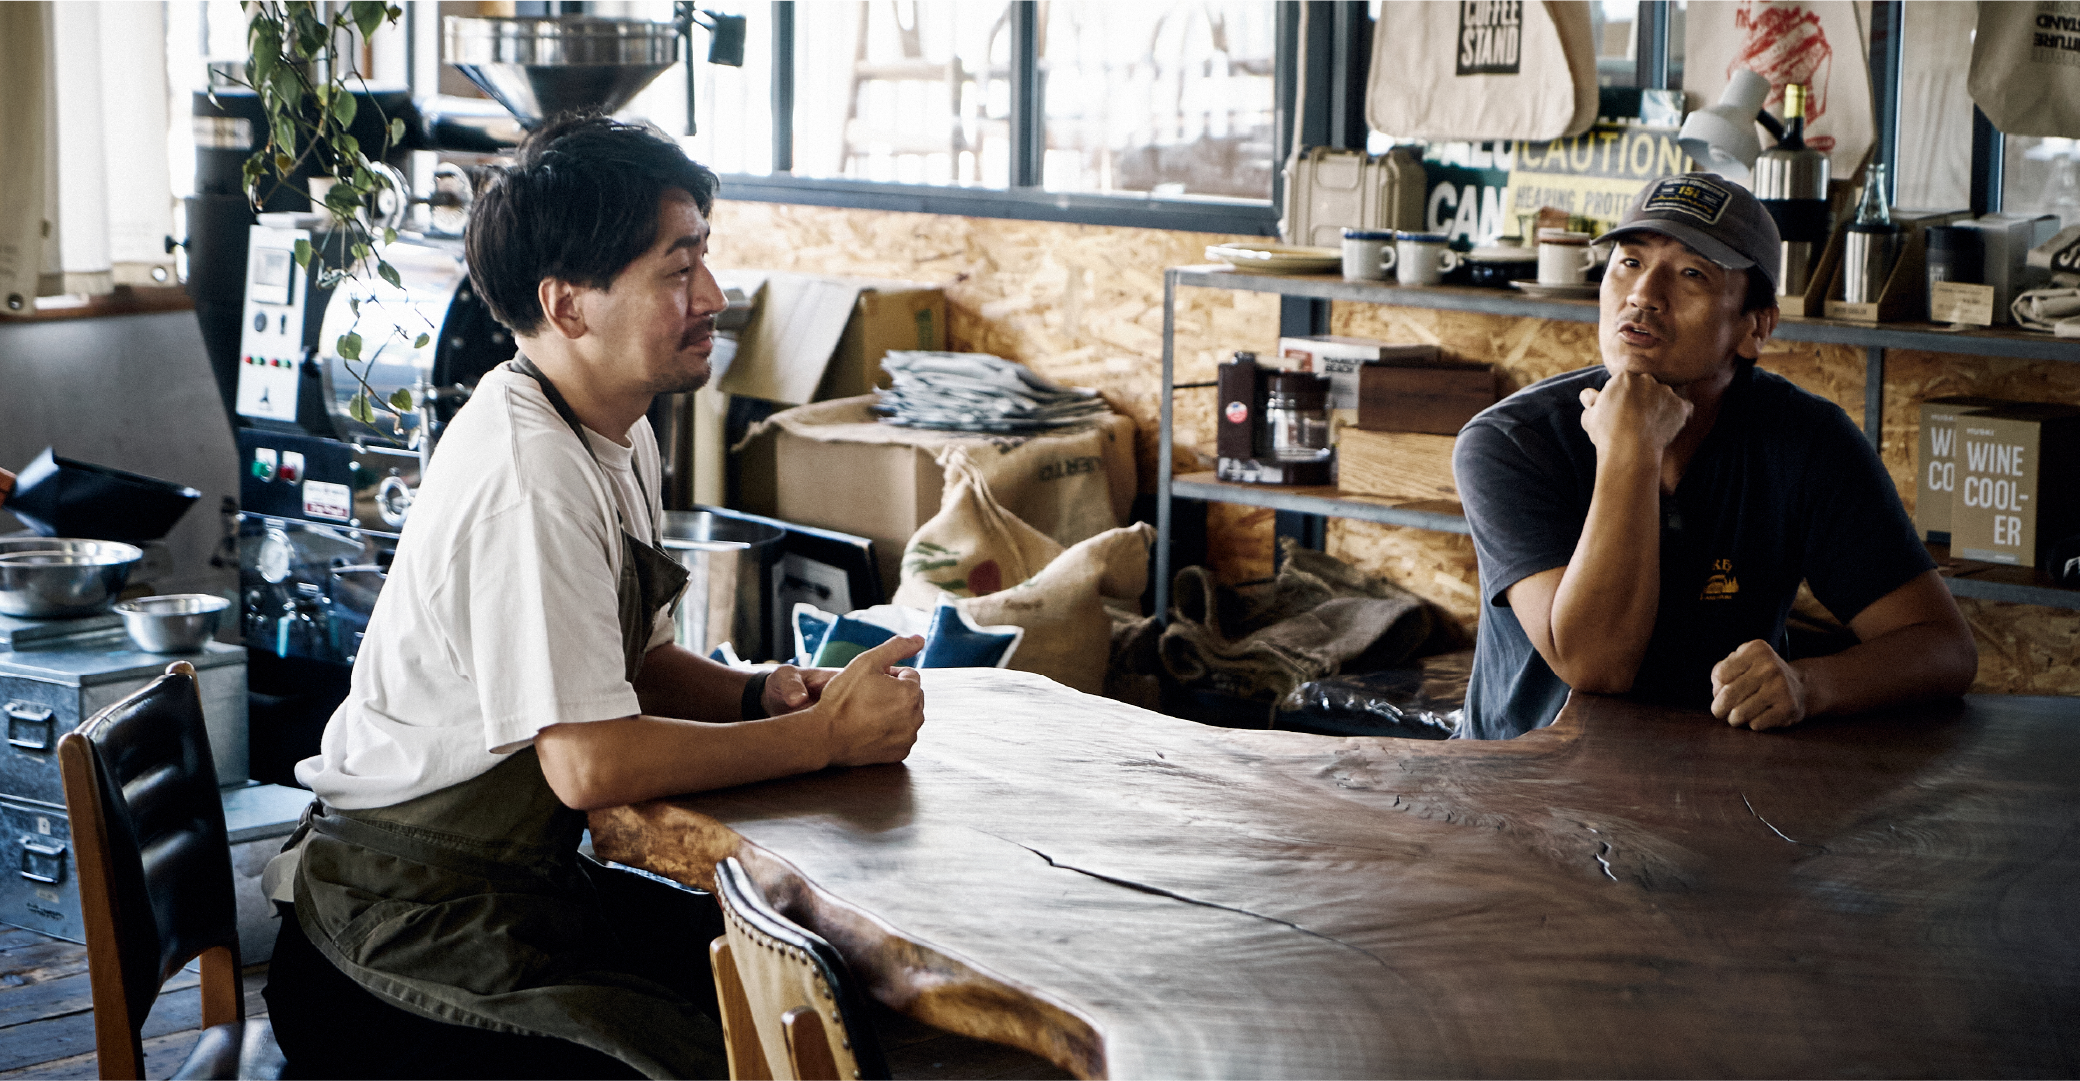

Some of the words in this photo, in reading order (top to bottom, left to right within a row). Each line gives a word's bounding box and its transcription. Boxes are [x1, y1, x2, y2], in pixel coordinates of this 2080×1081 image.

[1461, 26, 1519, 67] STAND
[1522, 131, 1682, 177] CAUTION
[1967, 441, 2024, 477] WINE
[1964, 476, 2029, 512] COOL-
[1994, 515, 2022, 547] ER
